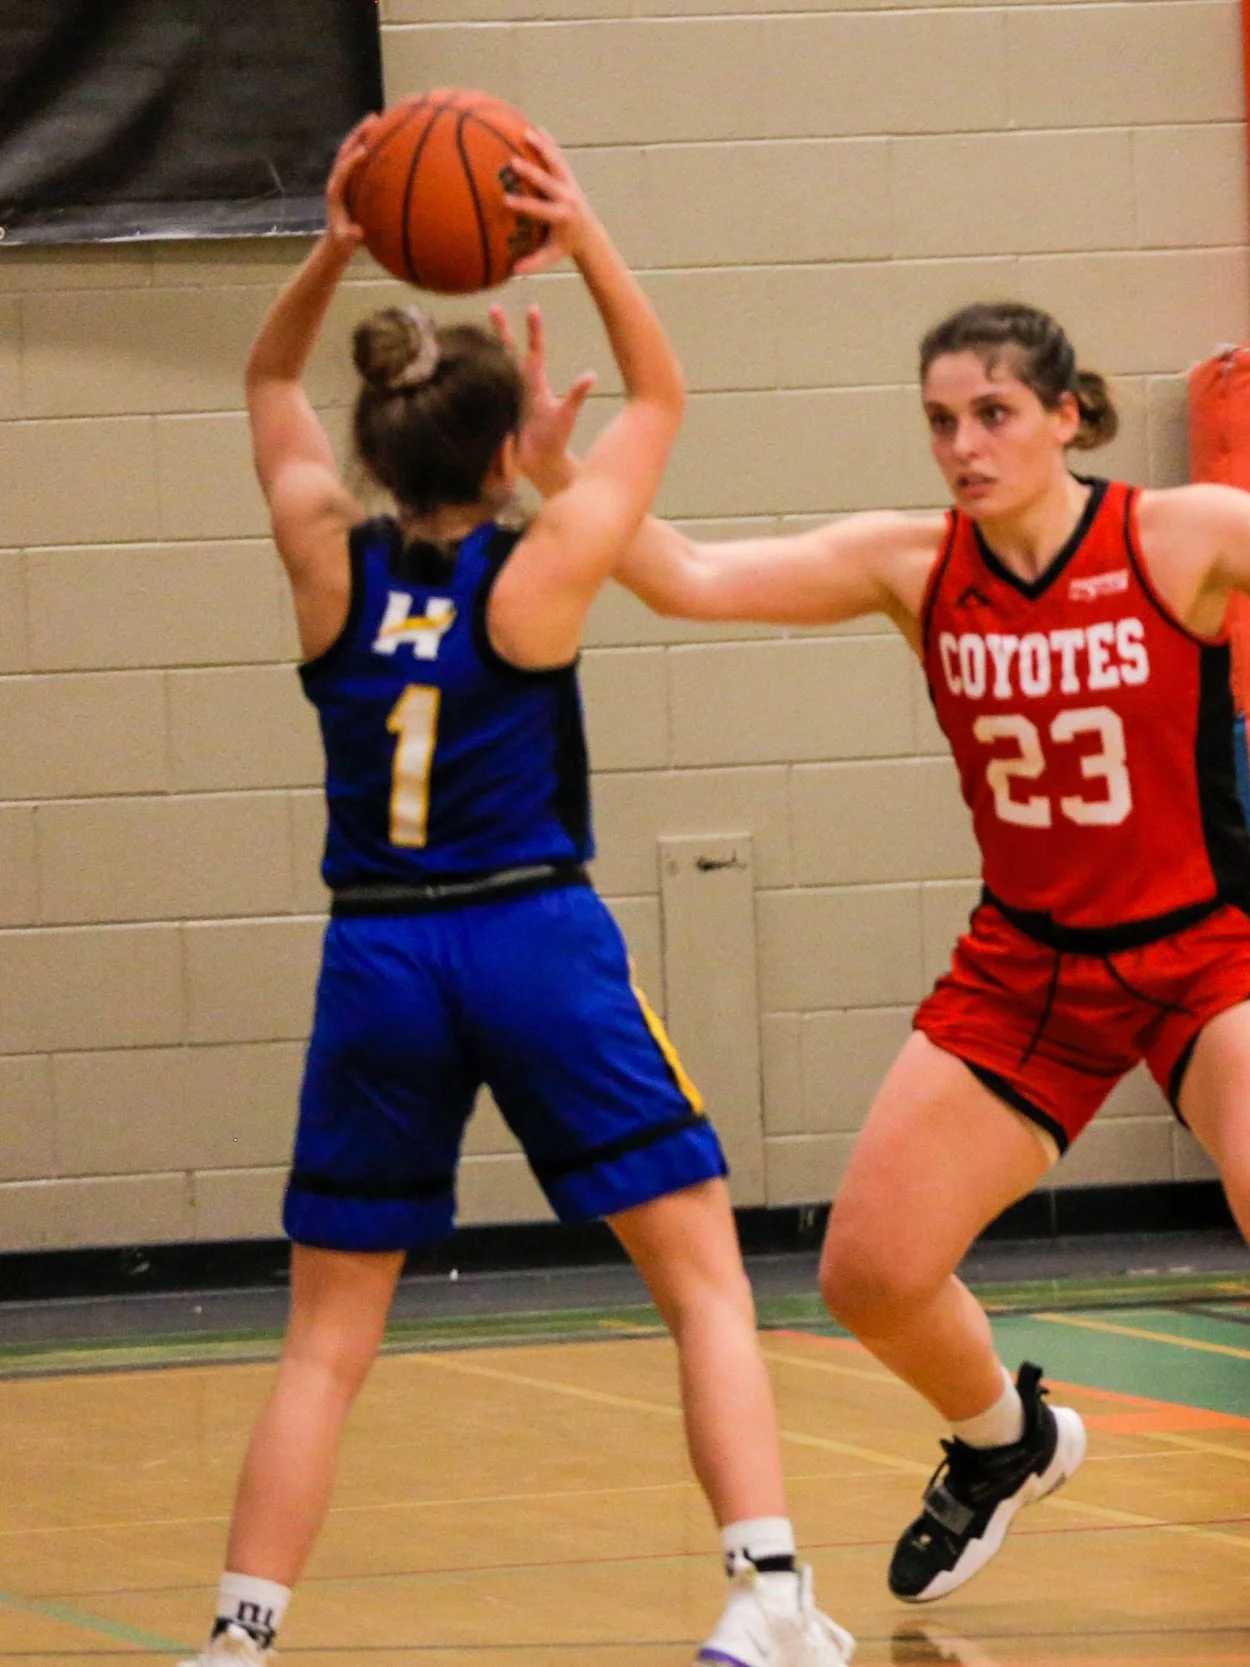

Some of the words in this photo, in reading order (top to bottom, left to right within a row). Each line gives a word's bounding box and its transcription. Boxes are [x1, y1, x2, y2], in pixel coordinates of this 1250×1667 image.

[938, 616, 1150, 700] COYOTES
[386, 683, 441, 848] 1
[972, 705, 1133, 829] 23
